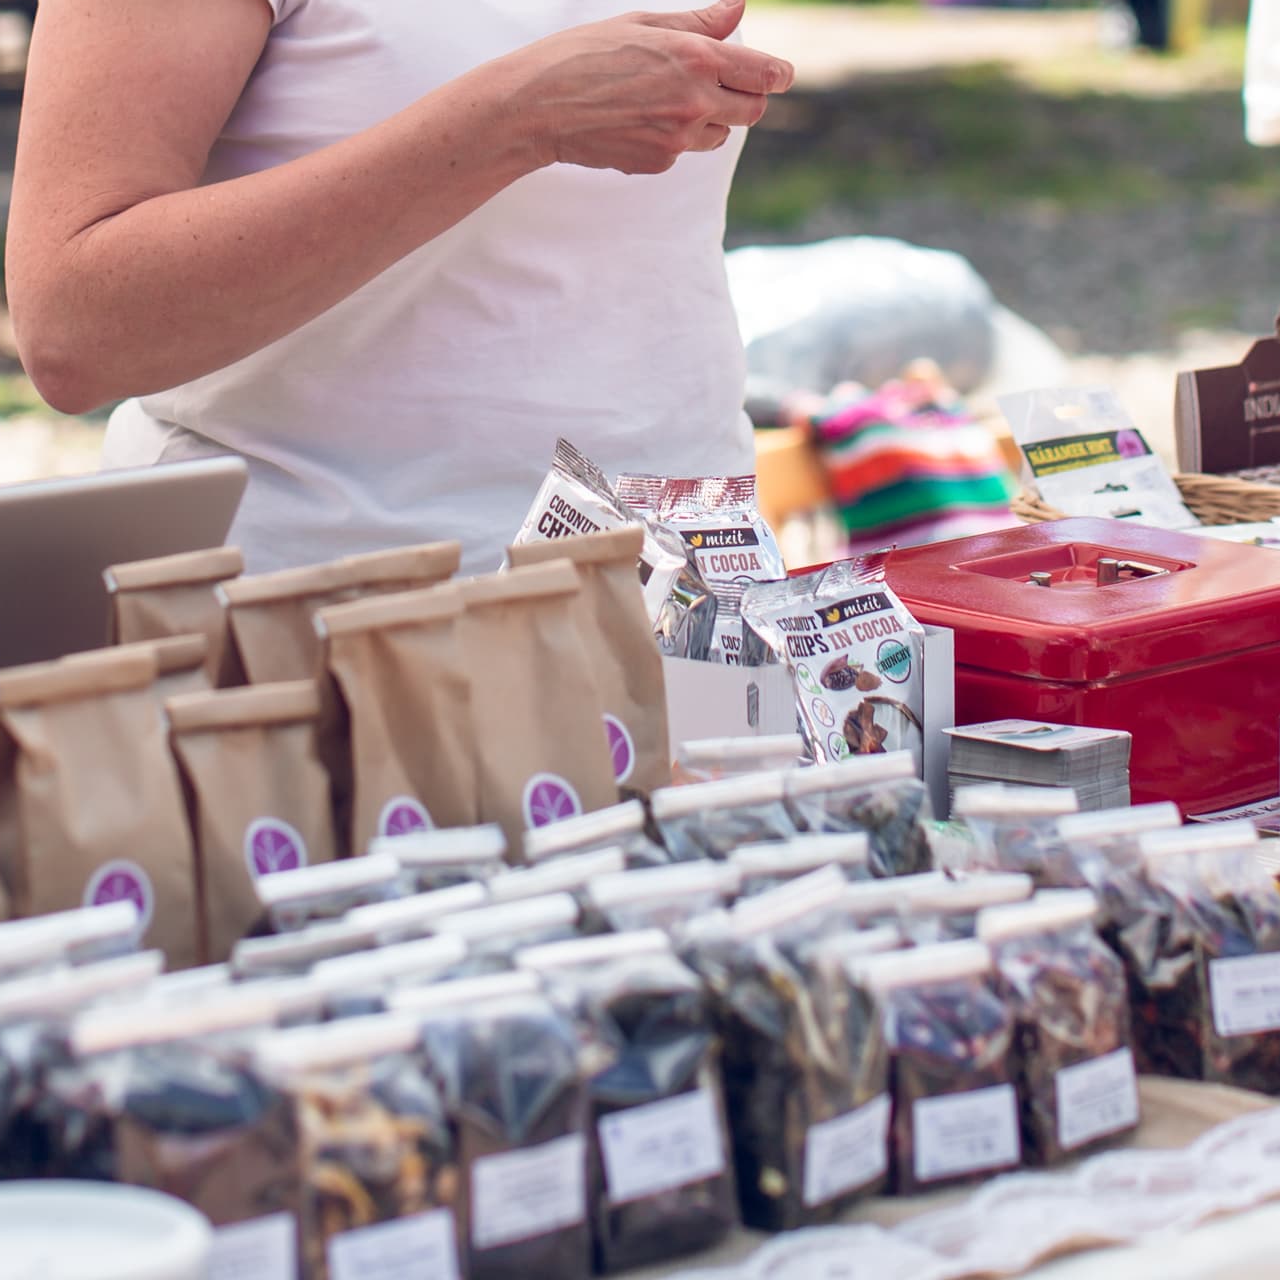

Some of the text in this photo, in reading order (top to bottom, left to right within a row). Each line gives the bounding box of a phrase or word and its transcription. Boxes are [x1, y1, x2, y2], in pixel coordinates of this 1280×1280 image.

[706, 530, 745, 547] mixit
[710, 552, 762, 573] COCOA
[843, 595, 881, 618] mixit
[776, 615, 818, 632] COCONUT
[786, 615, 904, 658] CHIPS IN COCOA
[877, 646, 912, 674] CRUNCHY
